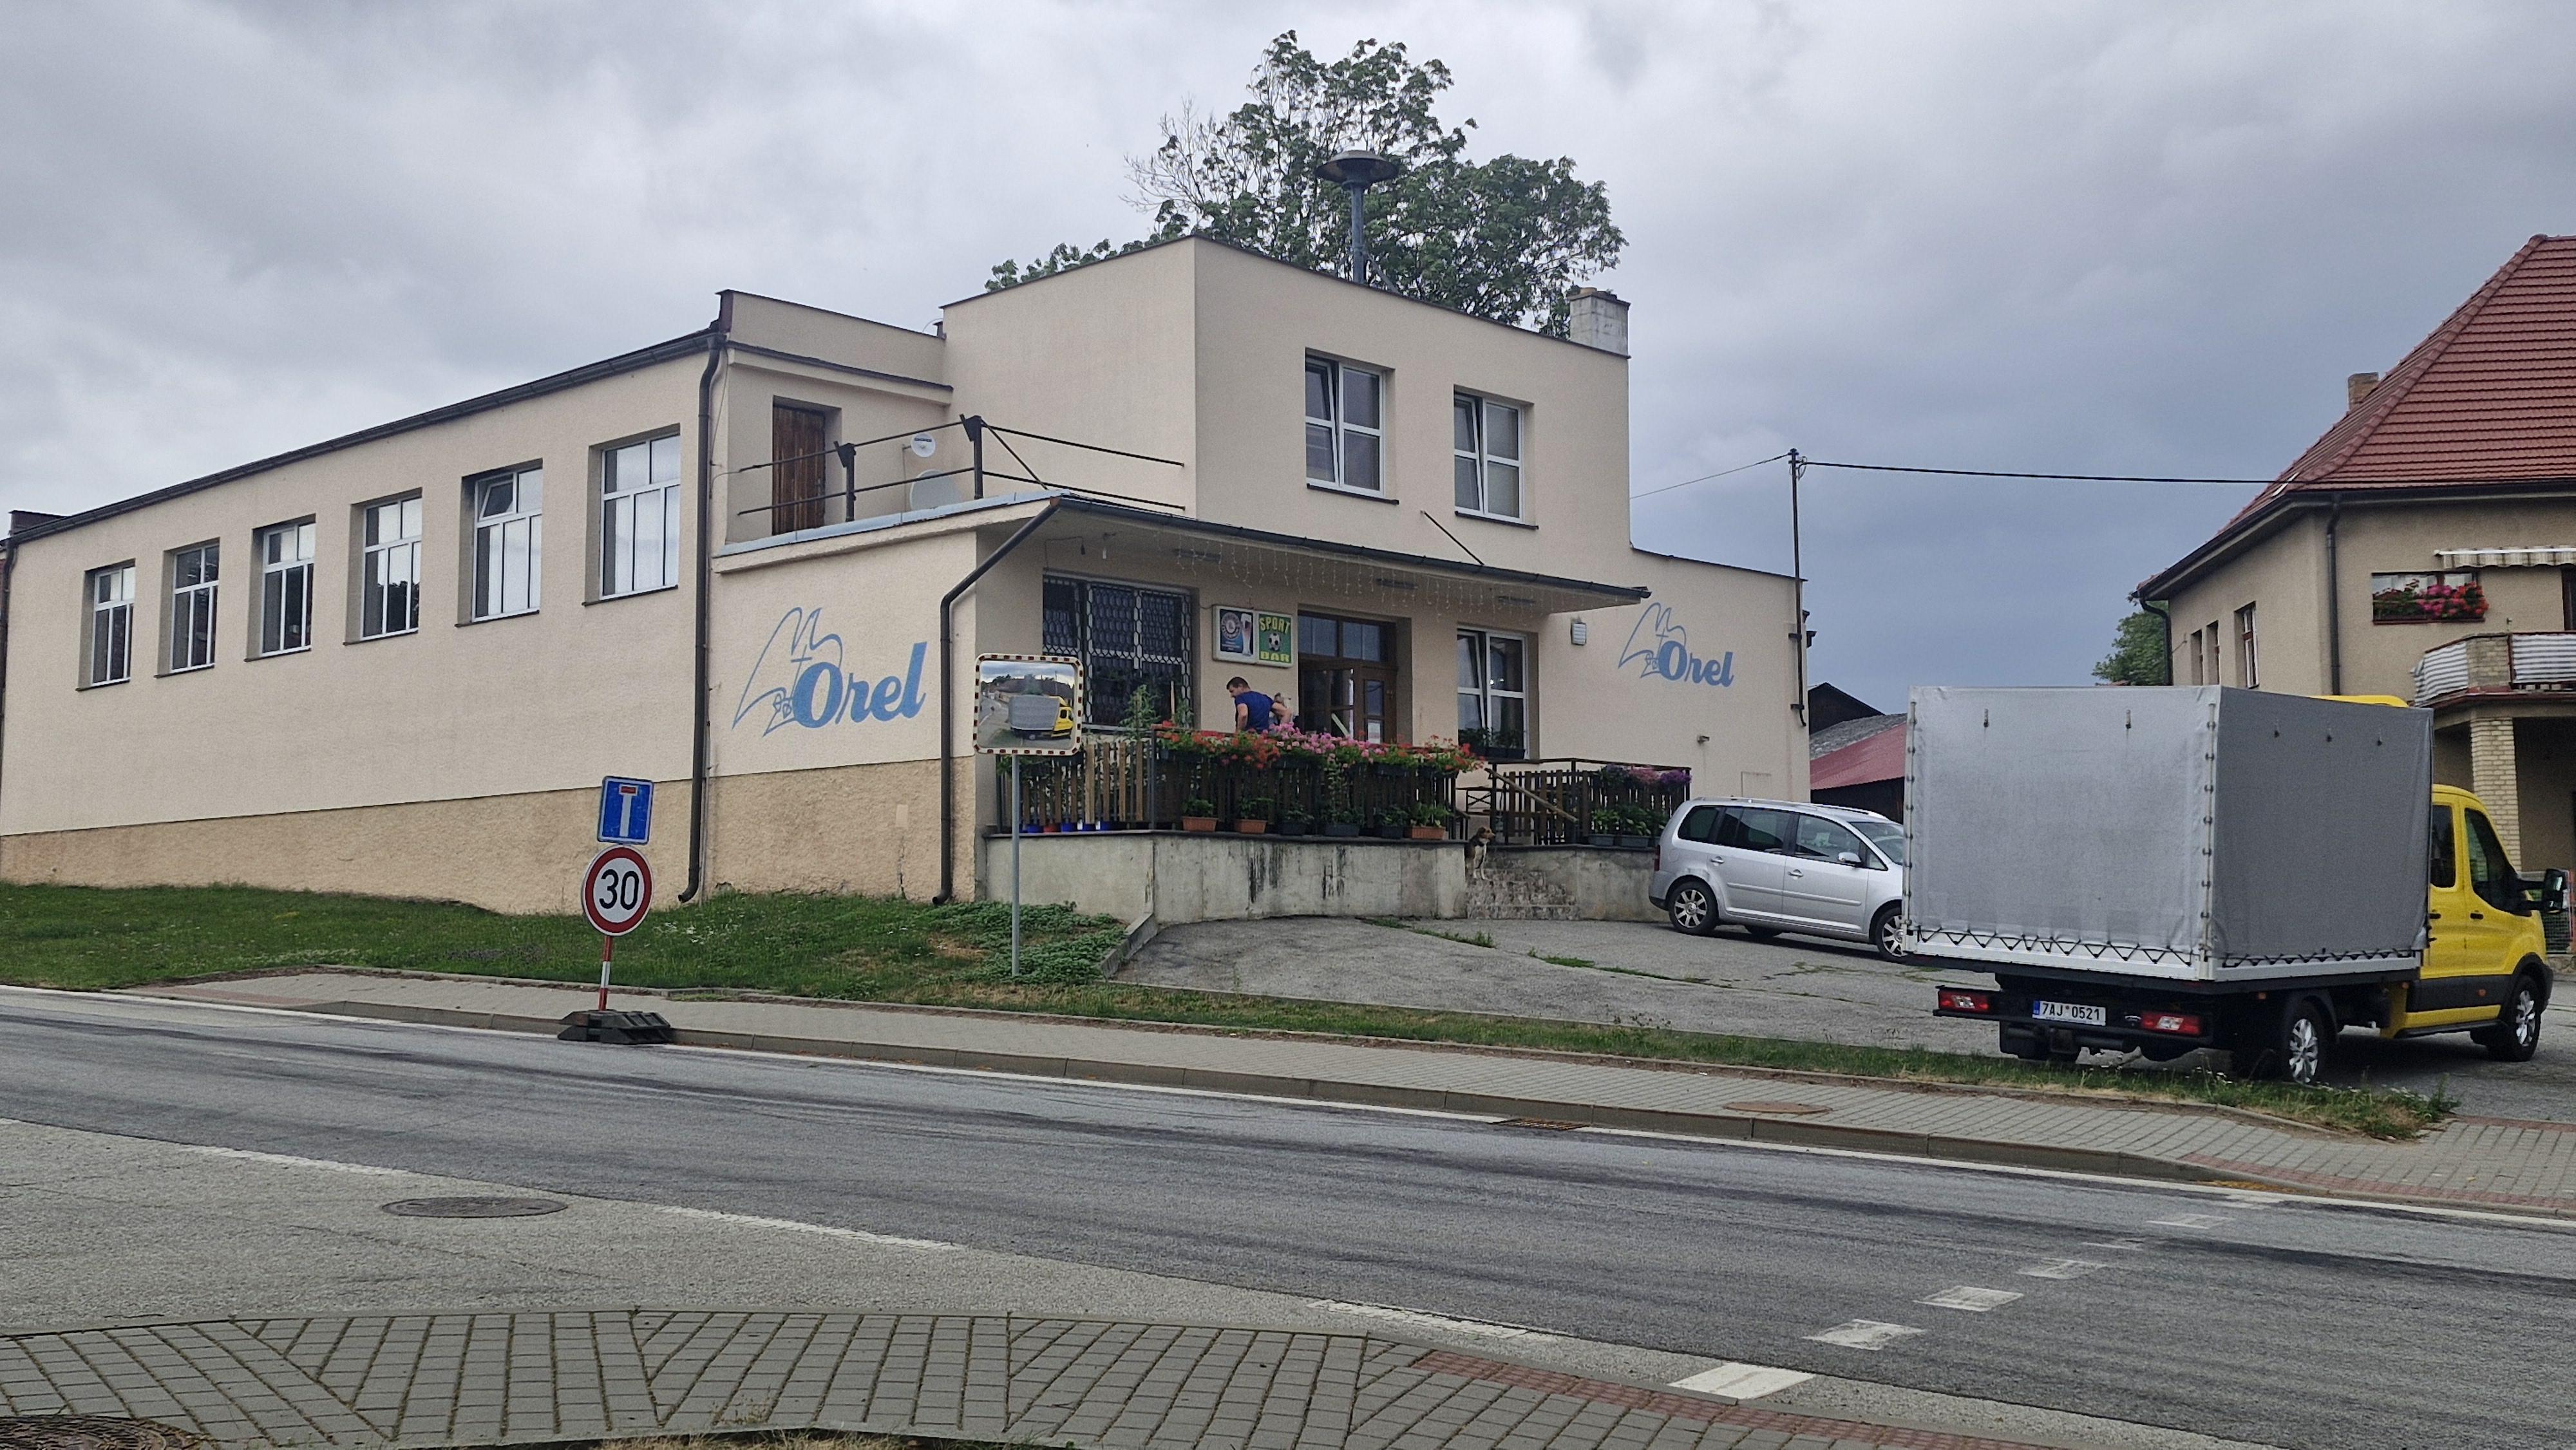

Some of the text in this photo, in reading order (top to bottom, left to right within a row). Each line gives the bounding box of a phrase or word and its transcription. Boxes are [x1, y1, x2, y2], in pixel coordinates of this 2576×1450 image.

[1260, 616, 1290, 634] SPORT
[1260, 651, 1289, 662] BAR
[1658, 640, 1734, 687] Orel
[793, 641, 927, 728] Orel
[600, 869, 639, 910] 30
[2042, 1003, 2063, 1016] 7AJ
[2072, 1006, 2099, 1021] 0521
